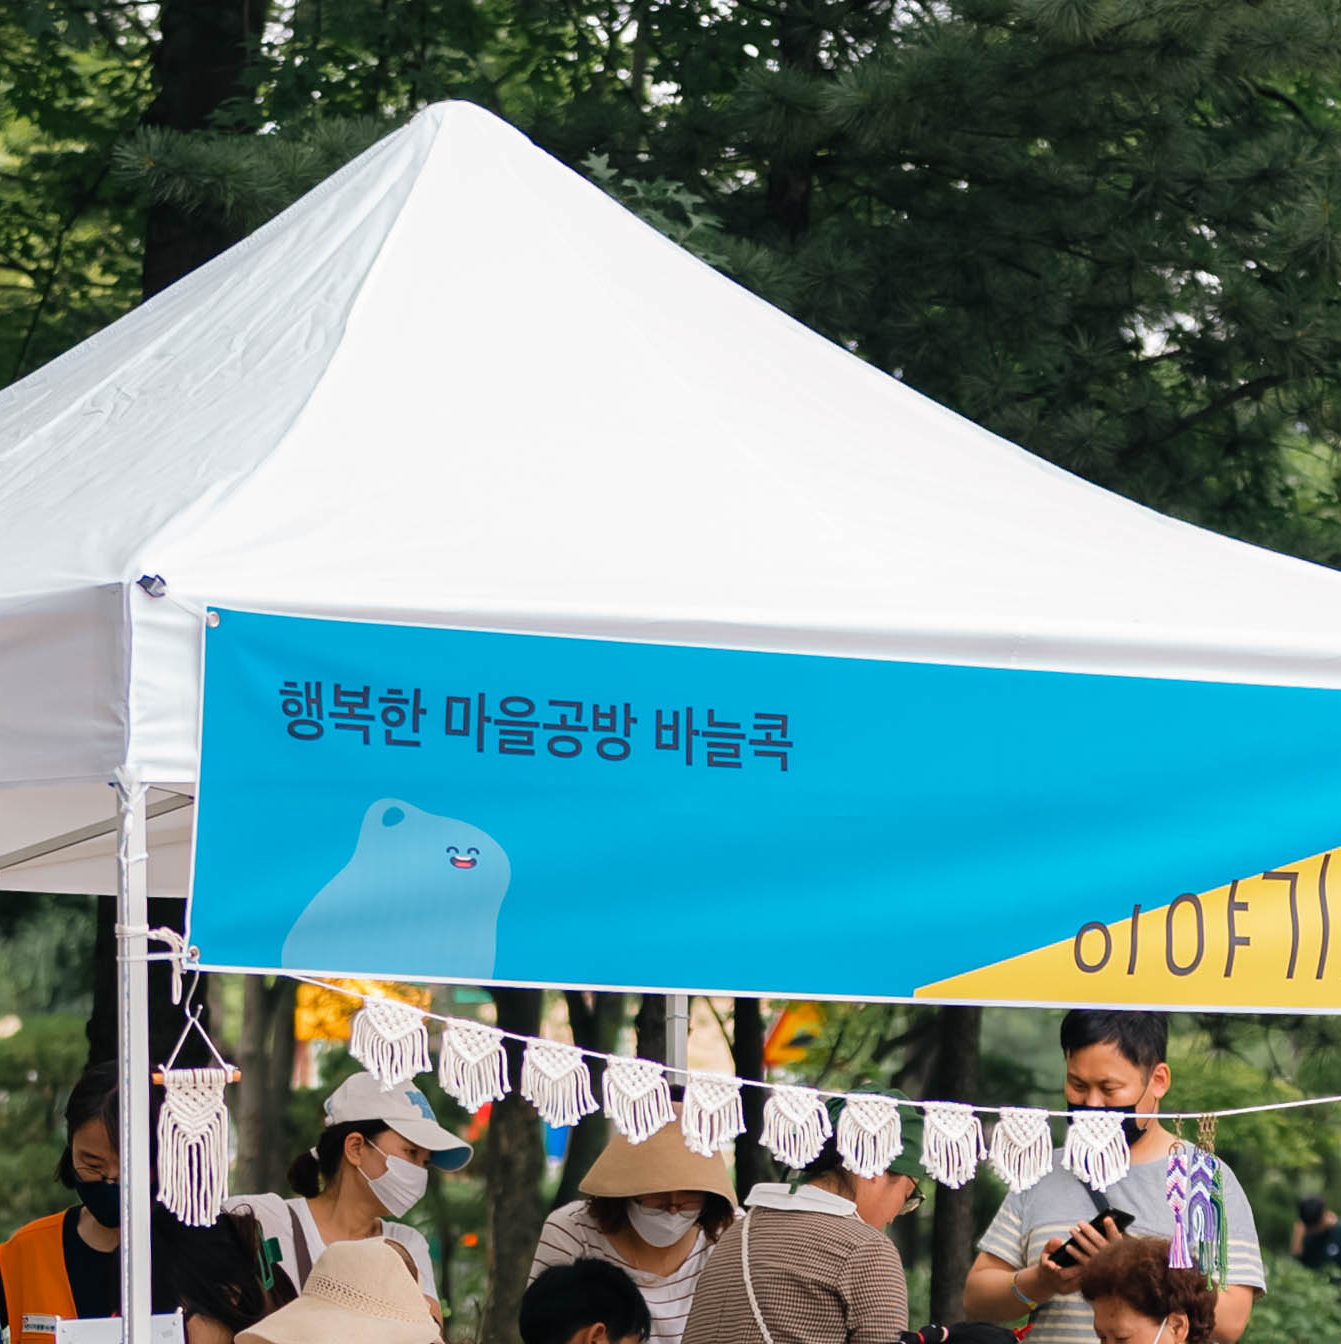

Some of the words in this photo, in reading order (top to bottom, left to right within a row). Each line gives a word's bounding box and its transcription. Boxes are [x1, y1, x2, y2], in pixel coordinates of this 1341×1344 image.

[278, 680, 428, 748] 행복한
[445, 692, 638, 761] 마을공방
[655, 707, 794, 772] 바늘콕
